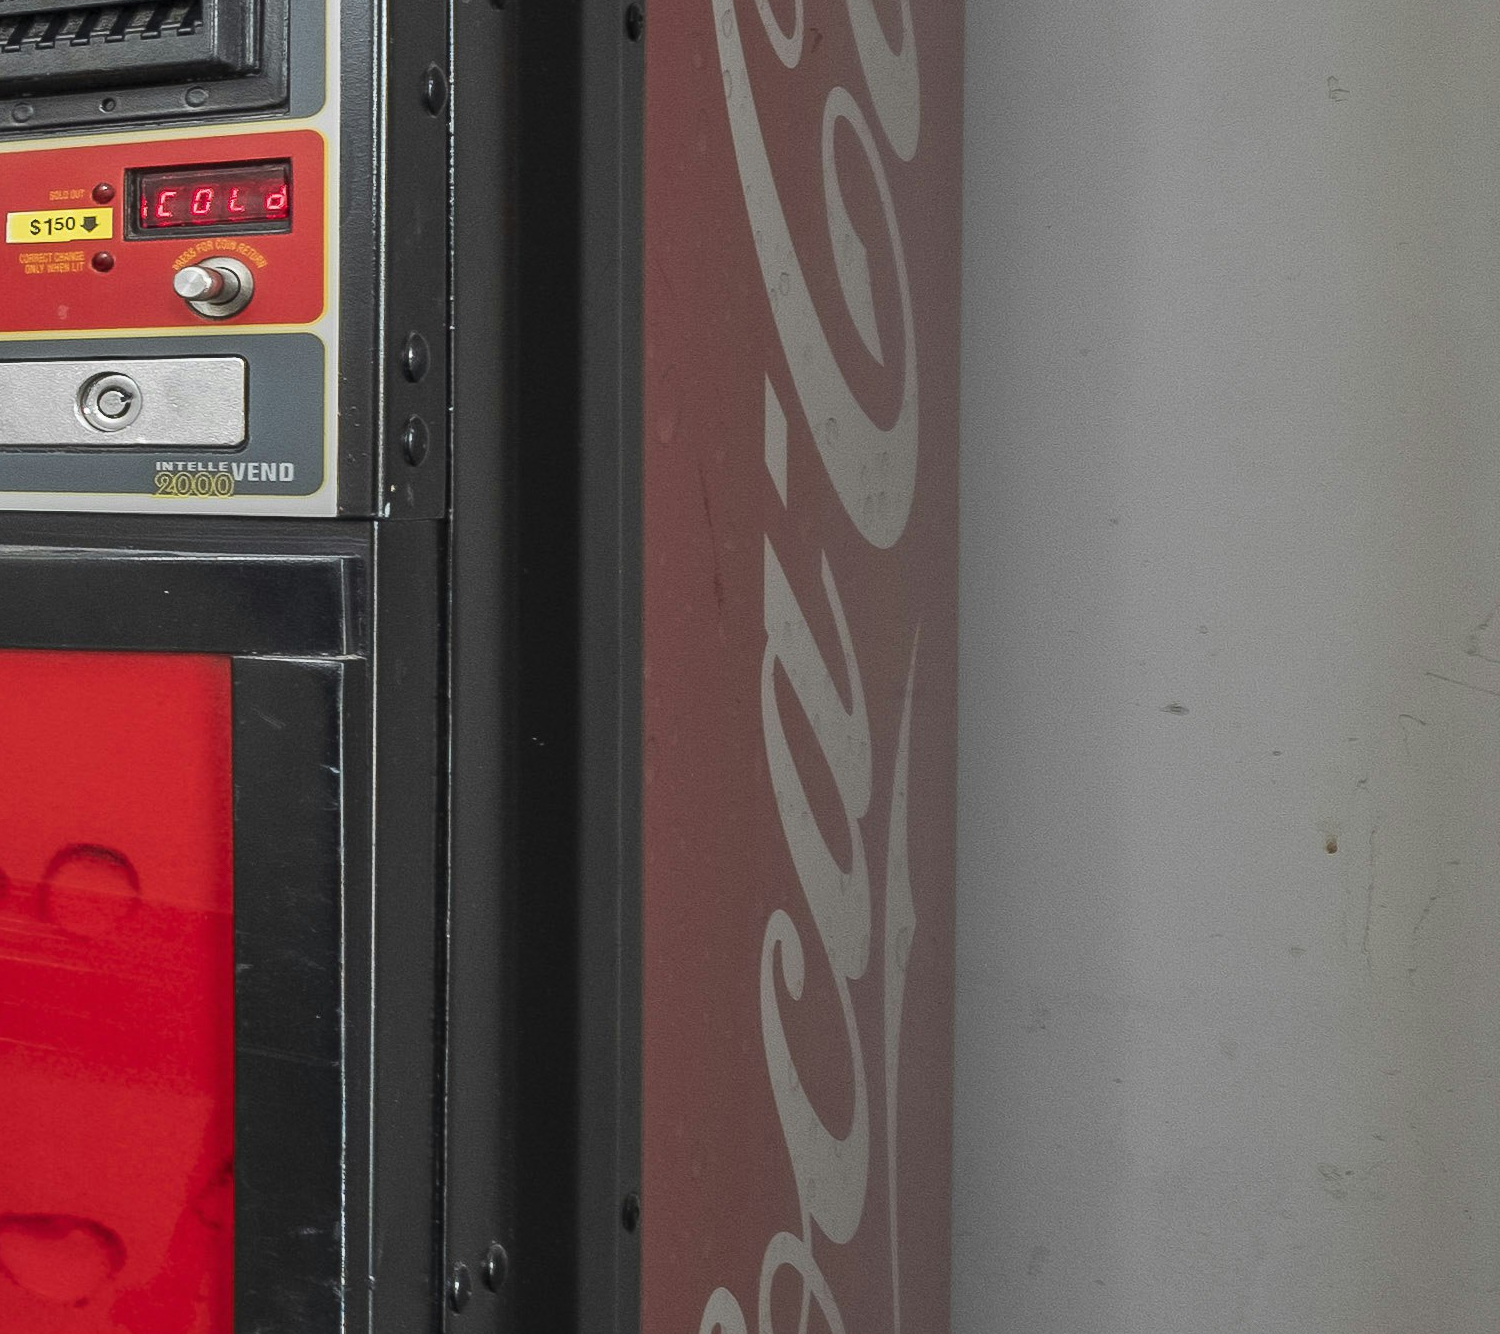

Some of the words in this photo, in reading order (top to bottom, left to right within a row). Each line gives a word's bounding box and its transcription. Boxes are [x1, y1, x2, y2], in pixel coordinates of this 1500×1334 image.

[49, 190, 69, 201] SOLD
[70, 189, 86, 200] OUT
[19, 252, 53, 264] CORRECT
[54, 250, 86, 263] CHANGE
[197, 239, 214, 254] FOR
[215, 238, 236, 252] COIN
[236, 242, 268, 270] RETURN
[24, 263, 45, 275] ONLY
[47, 262, 70, 274] WHEN
[71, 261, 86, 273] LIT
[154, 471, 235, 498] 2000
